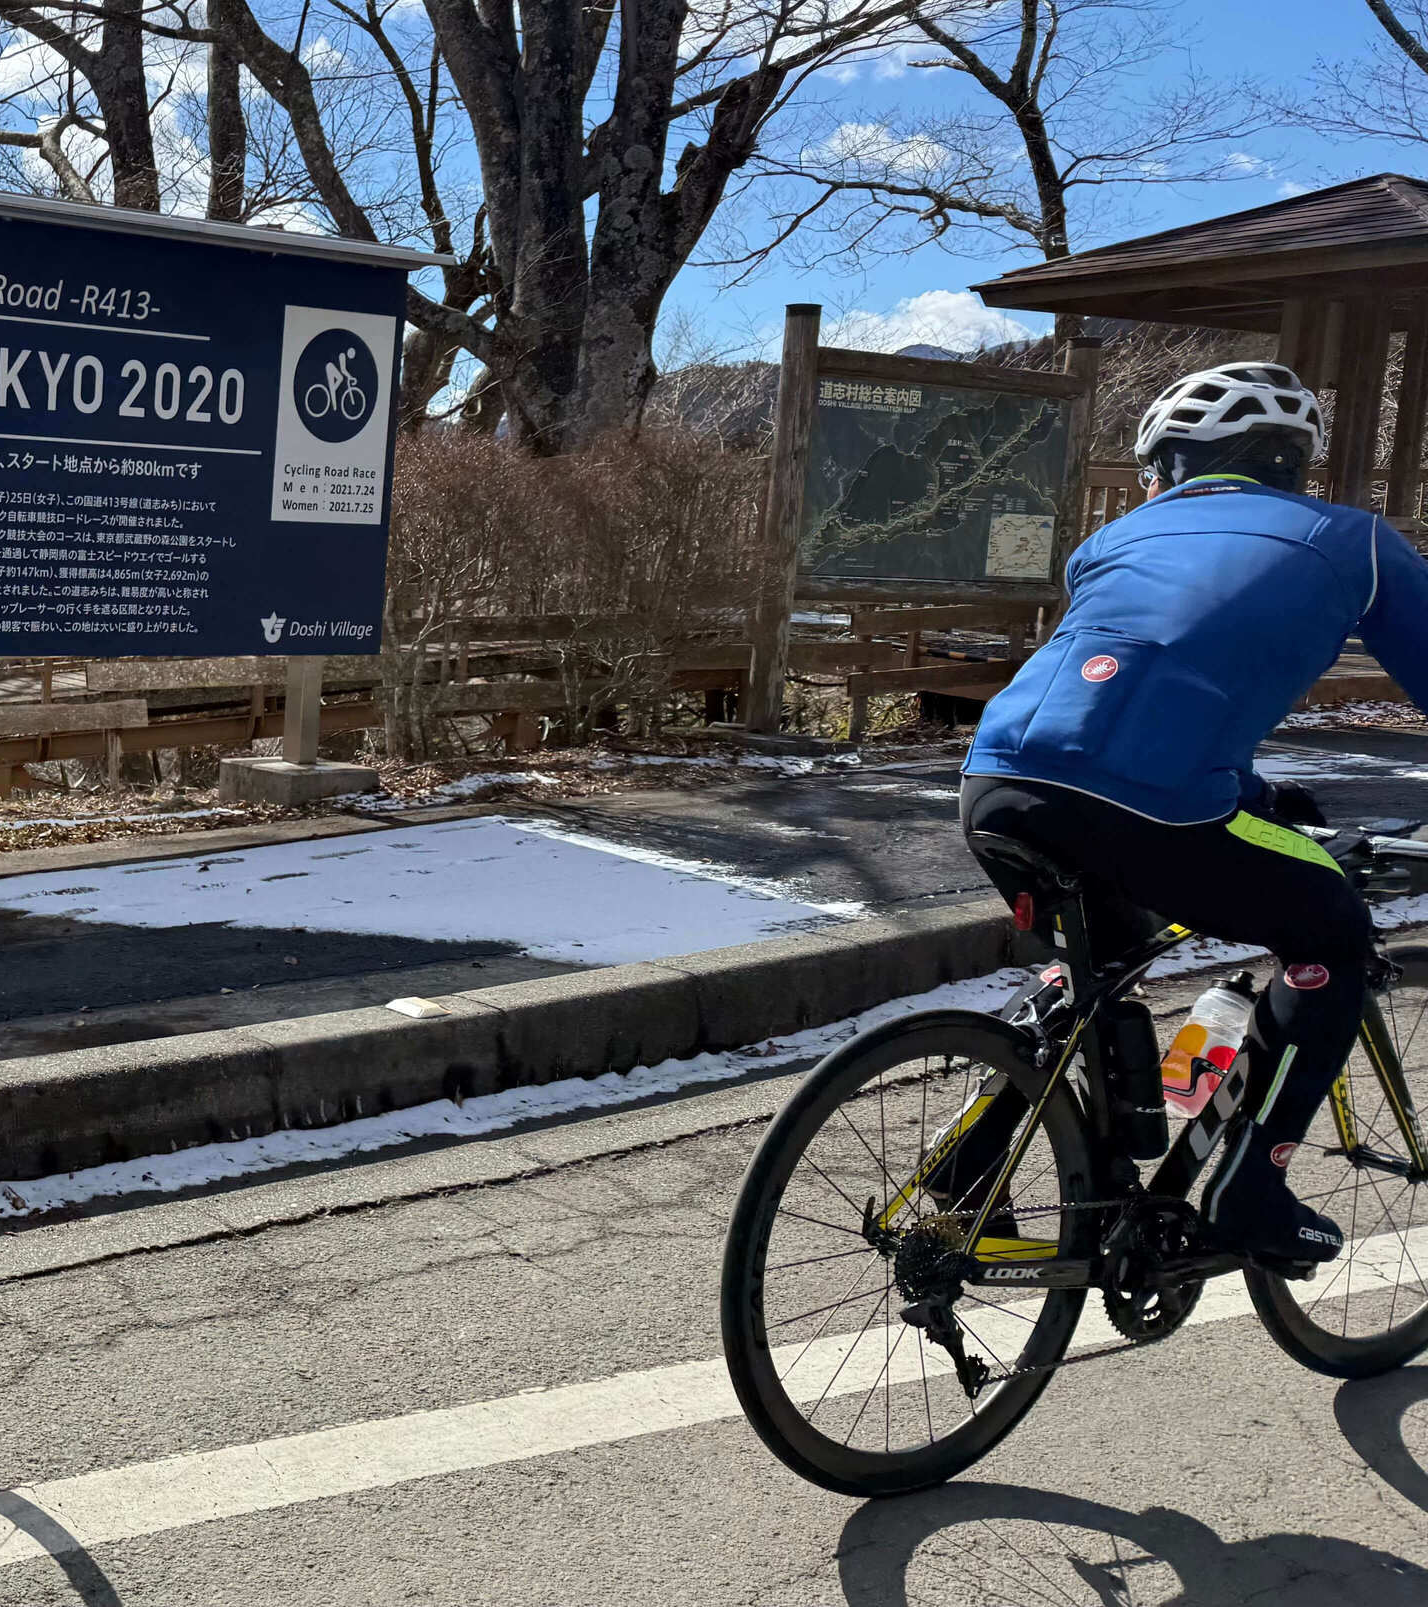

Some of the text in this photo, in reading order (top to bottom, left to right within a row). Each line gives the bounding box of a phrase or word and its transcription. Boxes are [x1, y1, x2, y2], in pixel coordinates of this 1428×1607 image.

[70, 285, 161, 321] -R413-
[118, 358, 245, 426] 2020
[284, 464, 377, 479] Cycling Road Race
[330, 484, 375, 496] 2021.7.24
[282, 499, 319, 511] Women
[329, 502, 374, 513] 2021.7.25
[289, 621, 373, 640] Doshi Village
[983, 1266, 1044, 1280] LOOK
